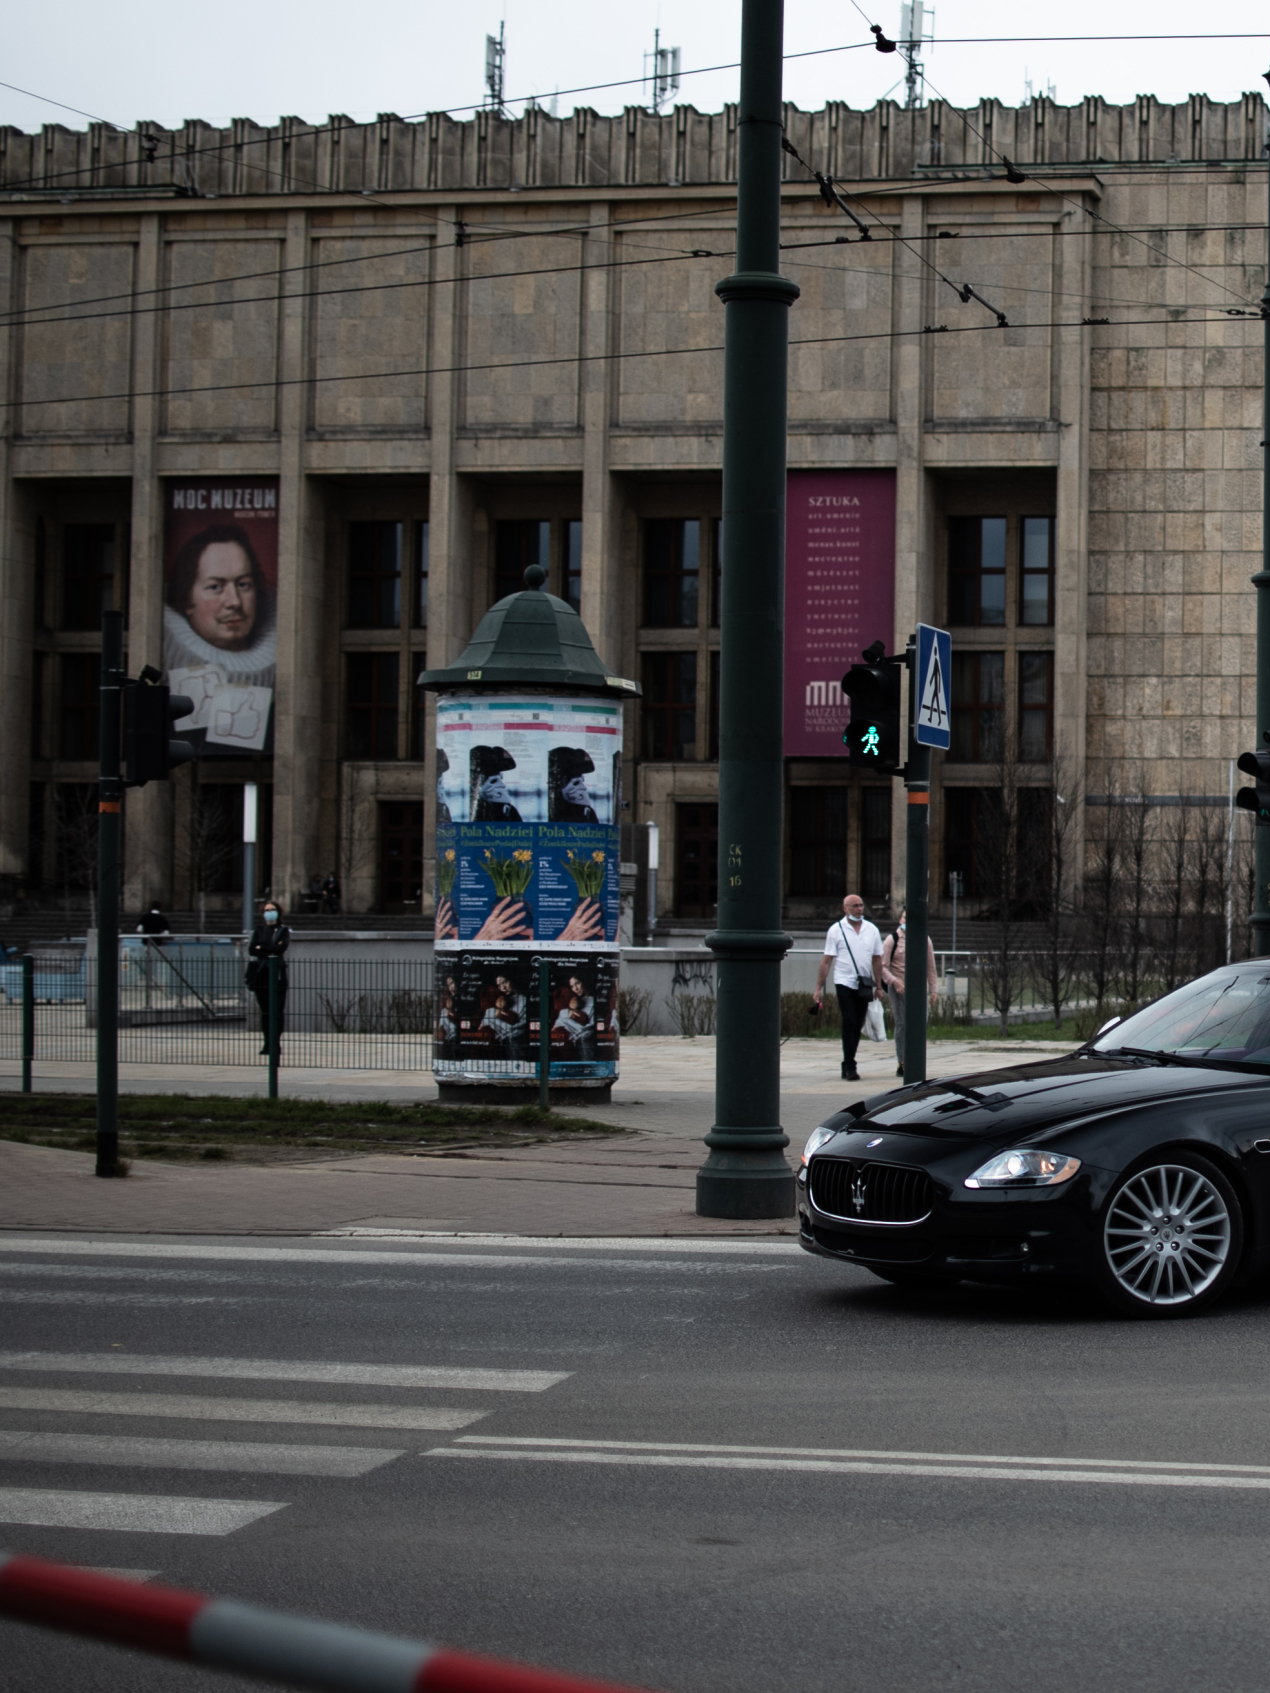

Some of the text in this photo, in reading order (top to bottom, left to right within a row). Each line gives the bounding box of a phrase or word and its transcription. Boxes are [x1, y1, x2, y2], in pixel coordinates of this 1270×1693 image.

[173, 488, 276, 510] MOC MUZEUM
[808, 496, 860, 507] SZTUKA
[460, 825, 482, 837] Pola
[485, 825, 534, 838] Nadziei
[538, 825, 565, 838] Pola
[568, 826, 606, 838] Nadziei
[729, 844, 742, 856] CK
[728, 857, 742, 868] 01
[729, 875, 742, 886] 16
